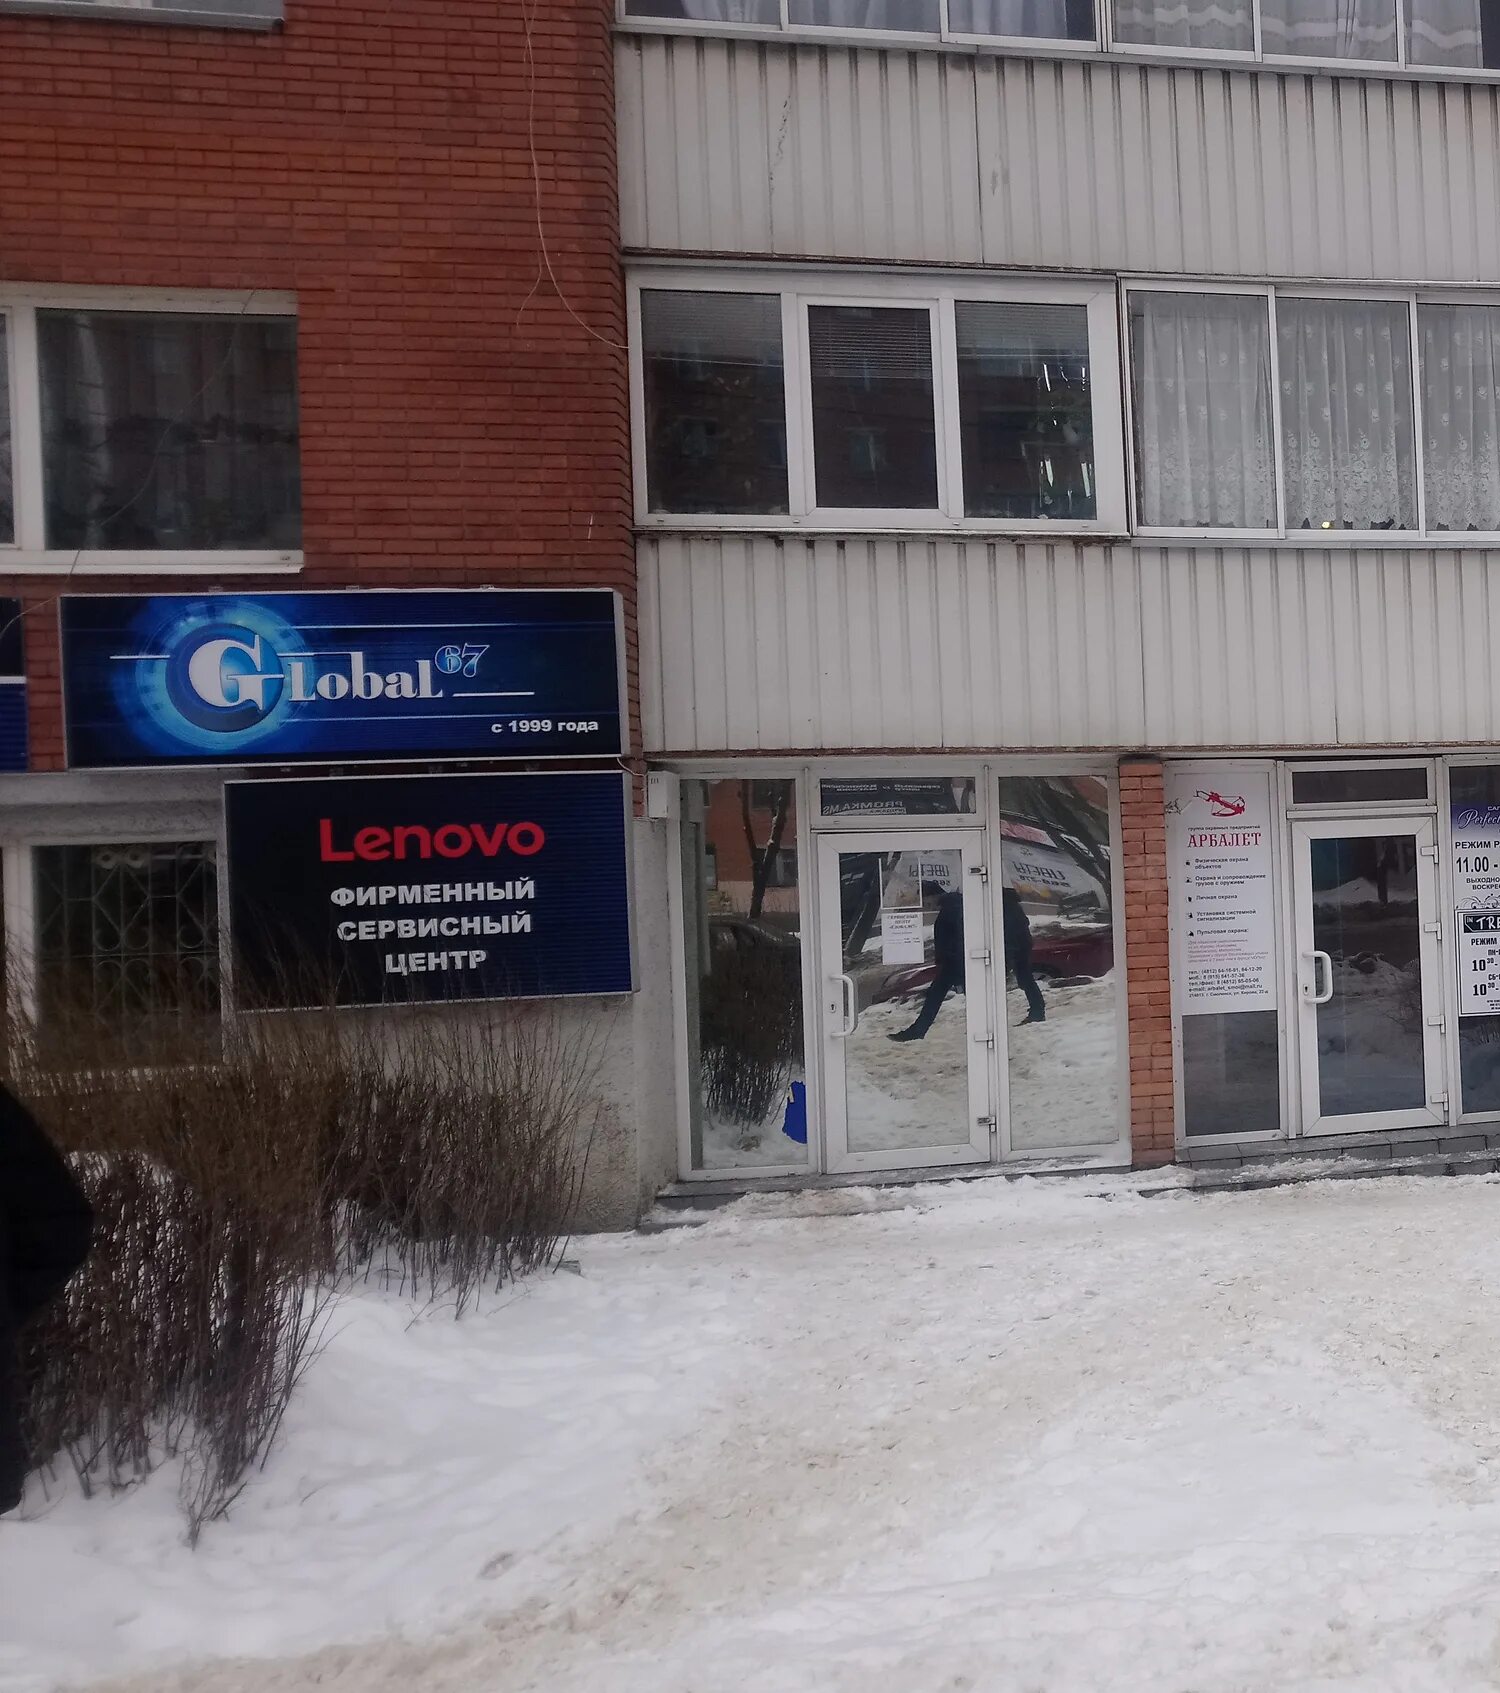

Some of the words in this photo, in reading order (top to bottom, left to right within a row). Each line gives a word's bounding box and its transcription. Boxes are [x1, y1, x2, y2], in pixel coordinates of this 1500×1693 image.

[435, 643, 490, 678] 67
[508, 719, 552, 732] 1999
[557, 721, 599, 733] года
[319, 818, 545, 861] Lenovo
[1187, 832, 1261, 848] АРБАЛЕТ
[1455, 841, 1491, 849] РЕЖИМ
[1456, 856, 1489, 873] 11.00
[330, 877, 535, 906] ФИРМЕННЫЙ
[337, 910, 531, 941] СЕРВИСНЫЙ
[385, 950, 487, 976] ЦЕНТР
